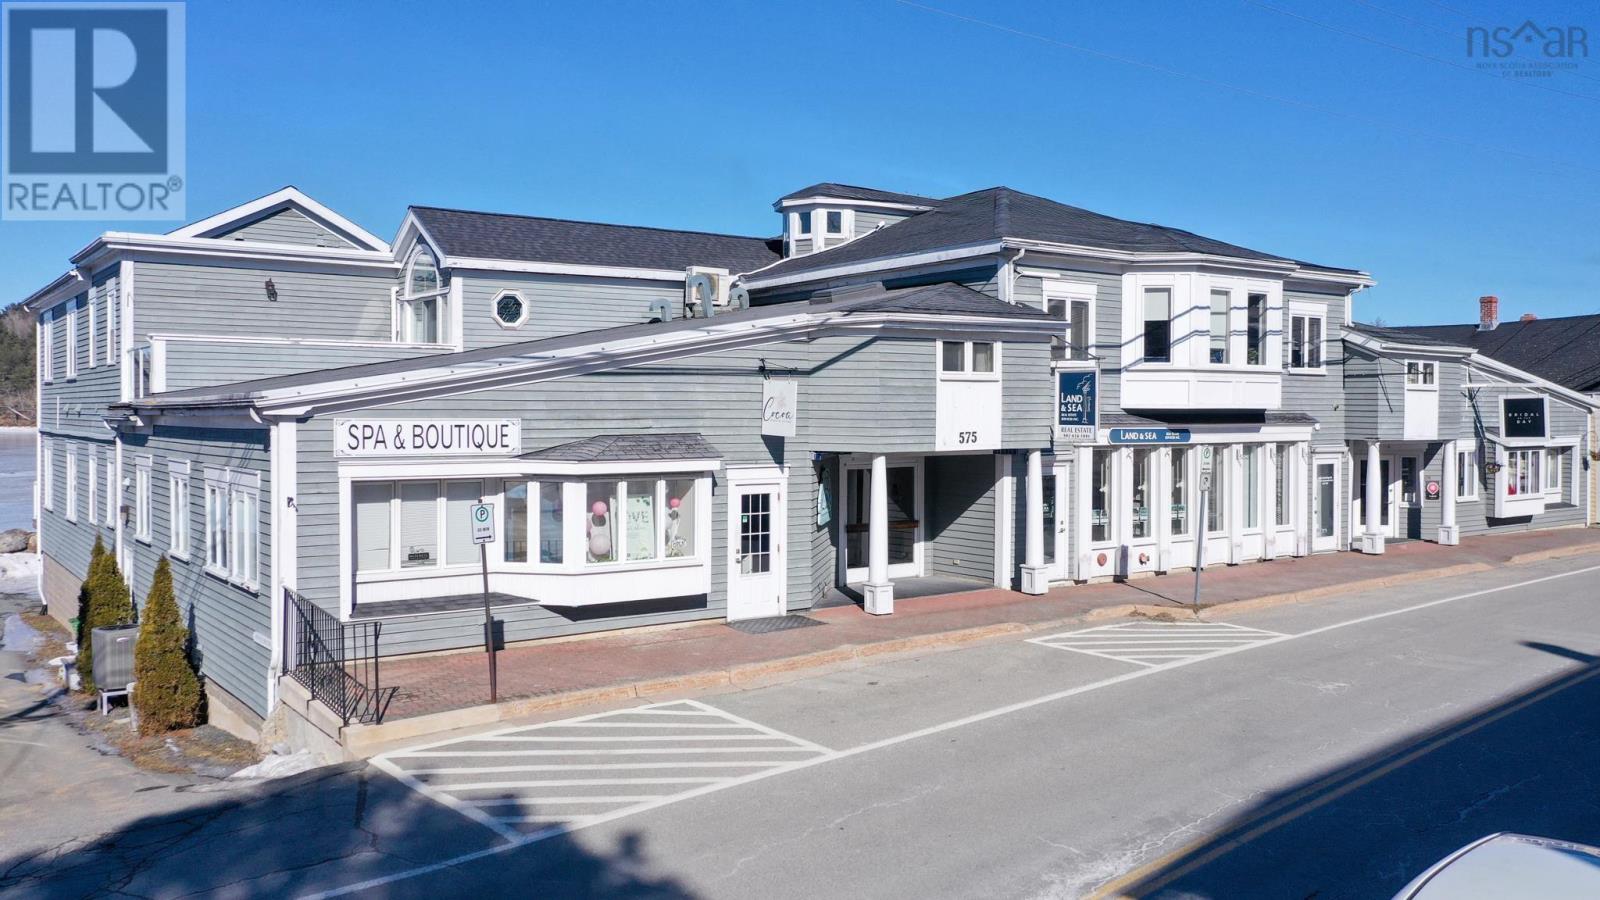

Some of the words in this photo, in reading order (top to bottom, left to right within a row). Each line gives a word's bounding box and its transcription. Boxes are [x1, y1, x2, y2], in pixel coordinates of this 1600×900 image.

[1060, 392, 1083, 403] LAND
[1060, 404, 1067, 412] &
[1067, 404, 1083, 412] SEA
[348, 424, 388, 450] SPA
[393, 424, 406, 450] &
[412, 424, 509, 451] BOUTIQUE
[959, 431, 977, 444] 575
[1120, 430, 1139, 440] LAND
[1144, 432, 1157, 440] SEA
